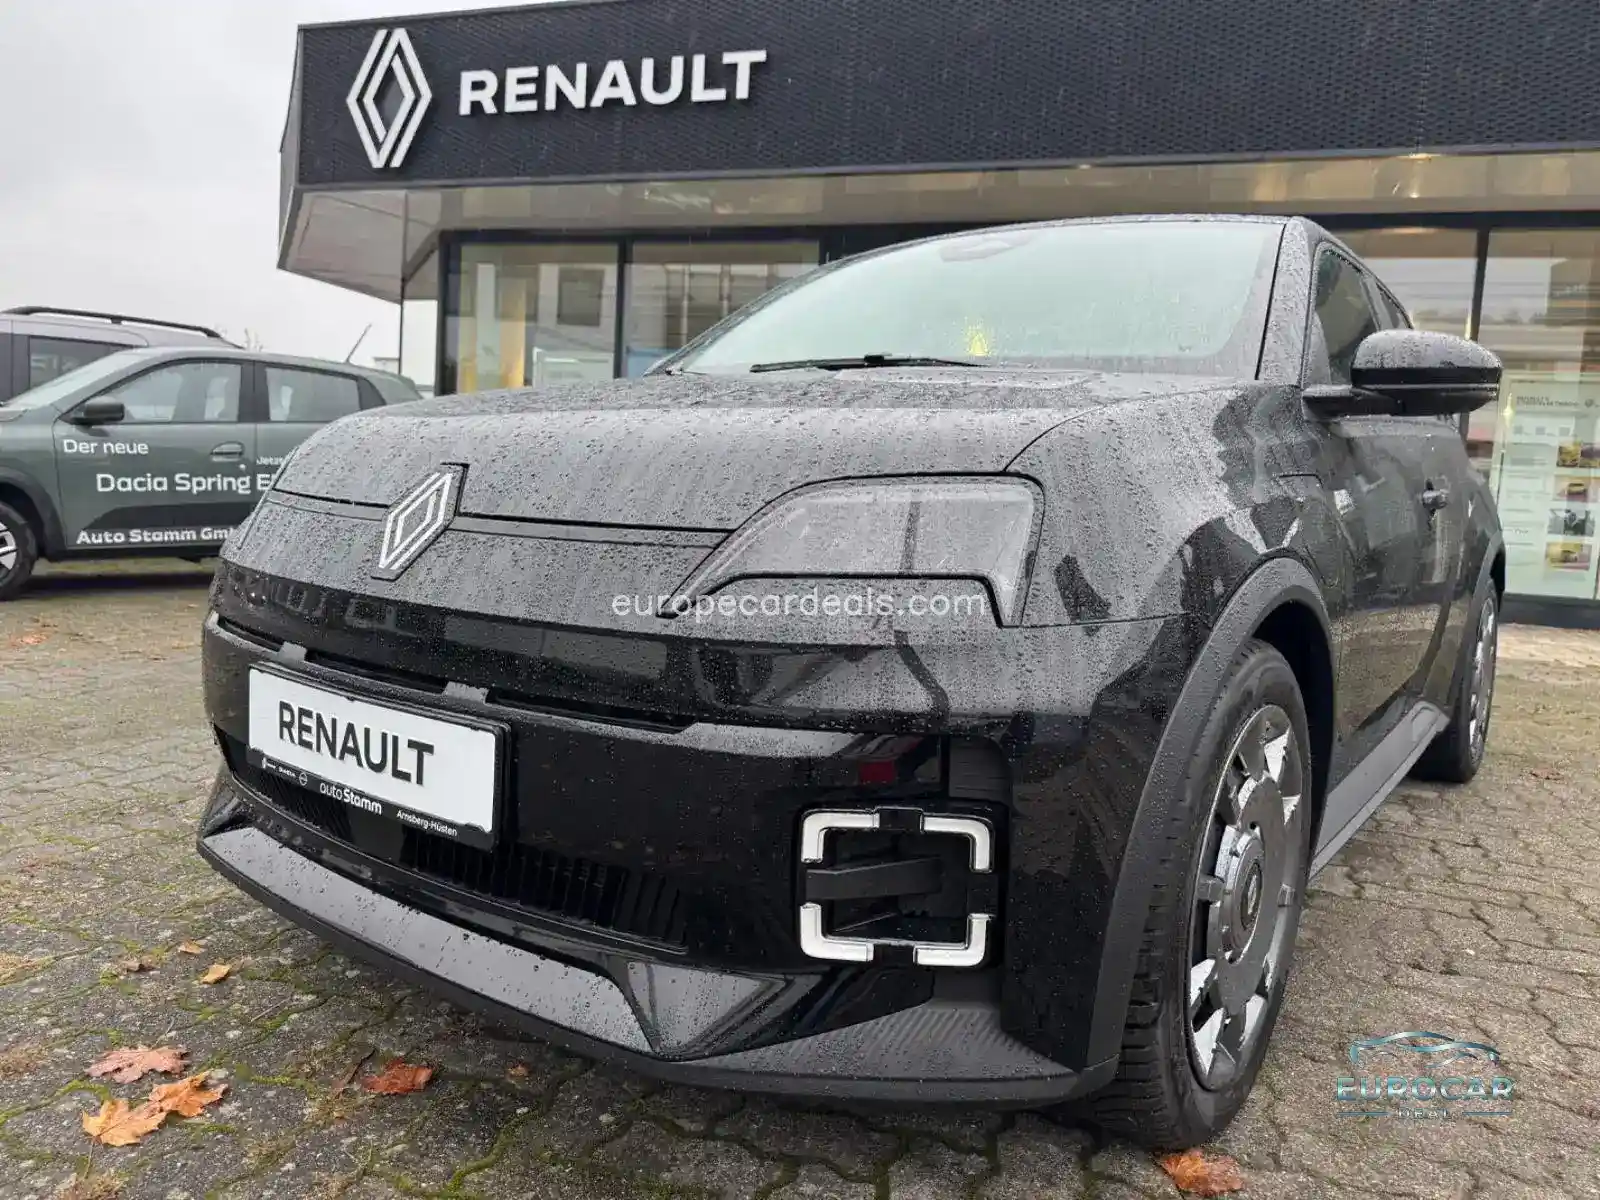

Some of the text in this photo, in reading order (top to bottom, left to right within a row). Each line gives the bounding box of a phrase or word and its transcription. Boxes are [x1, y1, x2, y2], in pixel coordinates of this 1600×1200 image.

[459, 49, 767, 116] RENAULT
[63, 439, 149, 455] Der neue
[96, 473, 168, 493] Dacia
[175, 472, 251, 495] Spring
[76, 530, 125, 545] Auto
[129, 529, 196, 543] Stamm
[278, 700, 435, 787] RENAULT
